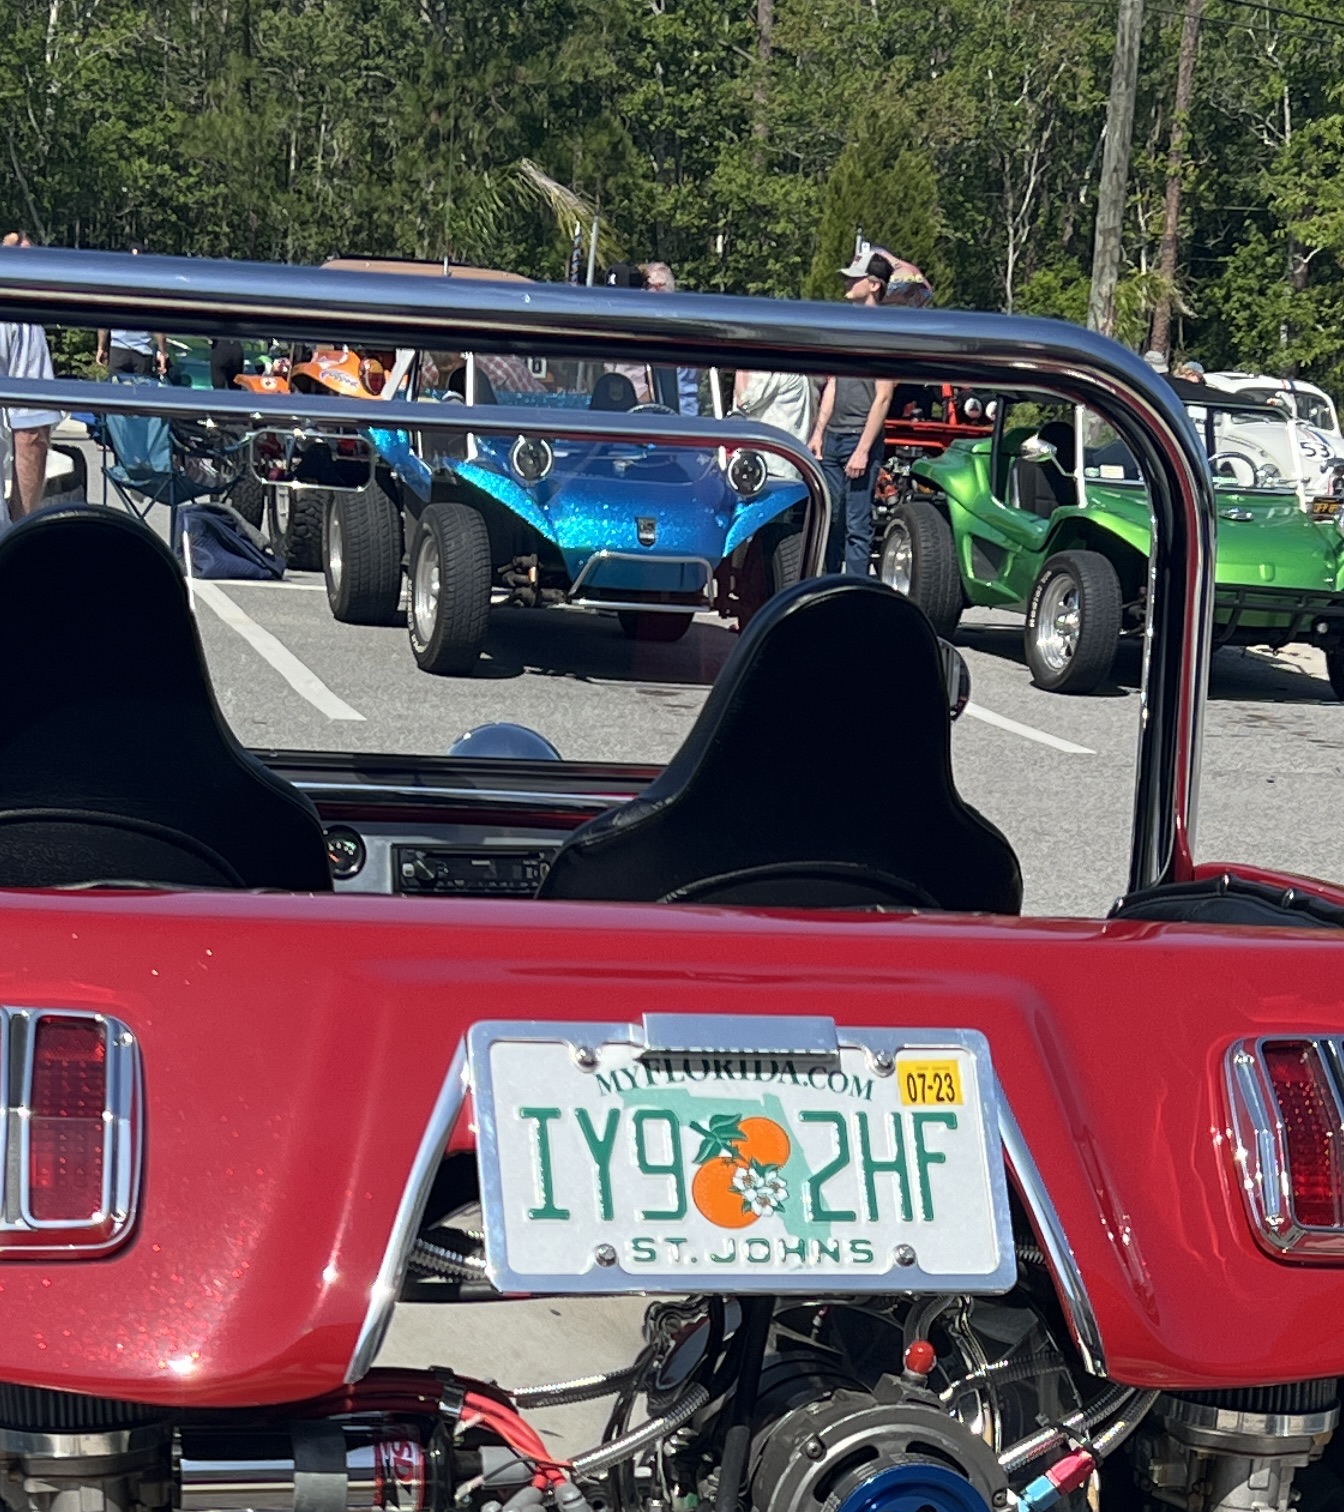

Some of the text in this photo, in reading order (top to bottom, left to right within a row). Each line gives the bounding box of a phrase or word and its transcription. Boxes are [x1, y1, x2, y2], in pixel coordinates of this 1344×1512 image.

[1300, 441, 1330, 458] 53
[596, 1055, 874, 1101] MYFLORIDA.COM
[906, 1072, 955, 1103] 07-23
[519, 1106, 958, 1223] IY9 2HF
[631, 1236, 874, 1265] ST. JOHNS
